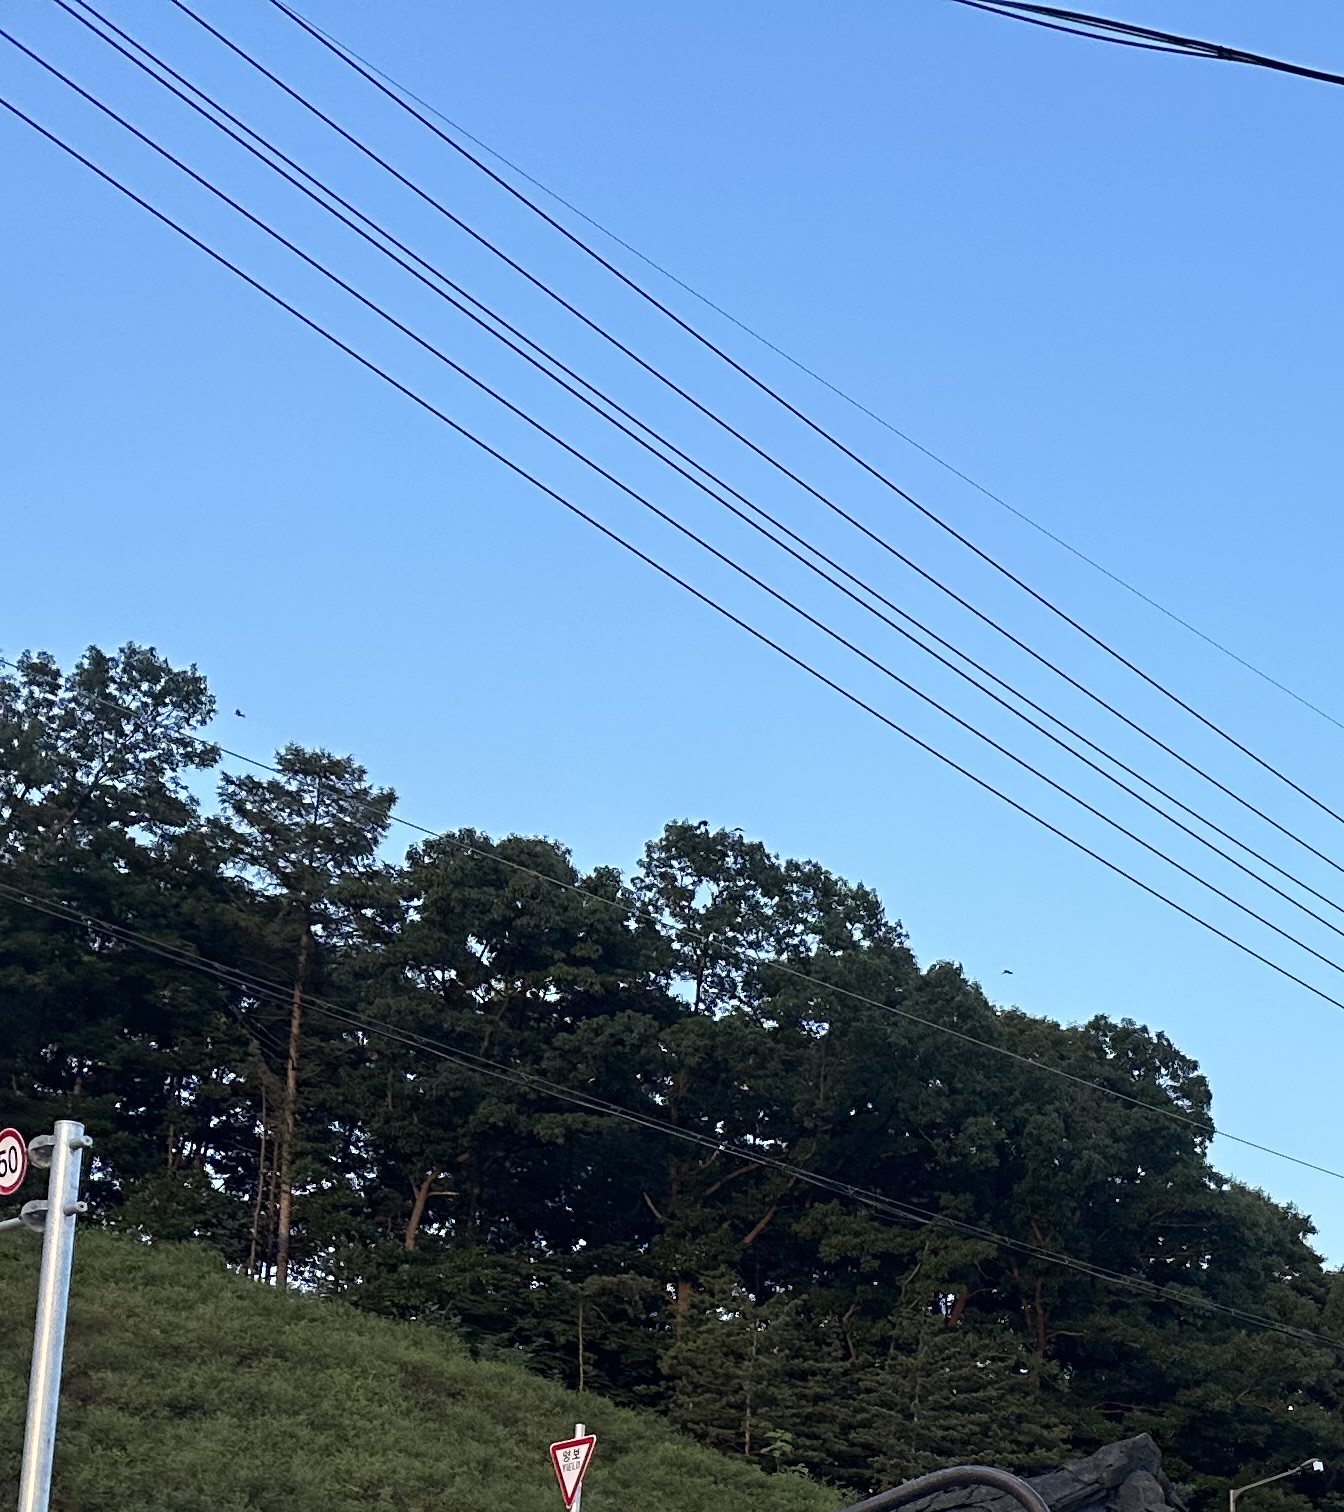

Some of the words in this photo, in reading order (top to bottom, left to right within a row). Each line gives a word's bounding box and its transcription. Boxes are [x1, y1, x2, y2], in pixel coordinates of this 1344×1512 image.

[0, 1145, 18, 1178] 50
[562, 1448, 581, 1462] 양보
[562, 1461, 581, 1472] YIELD
